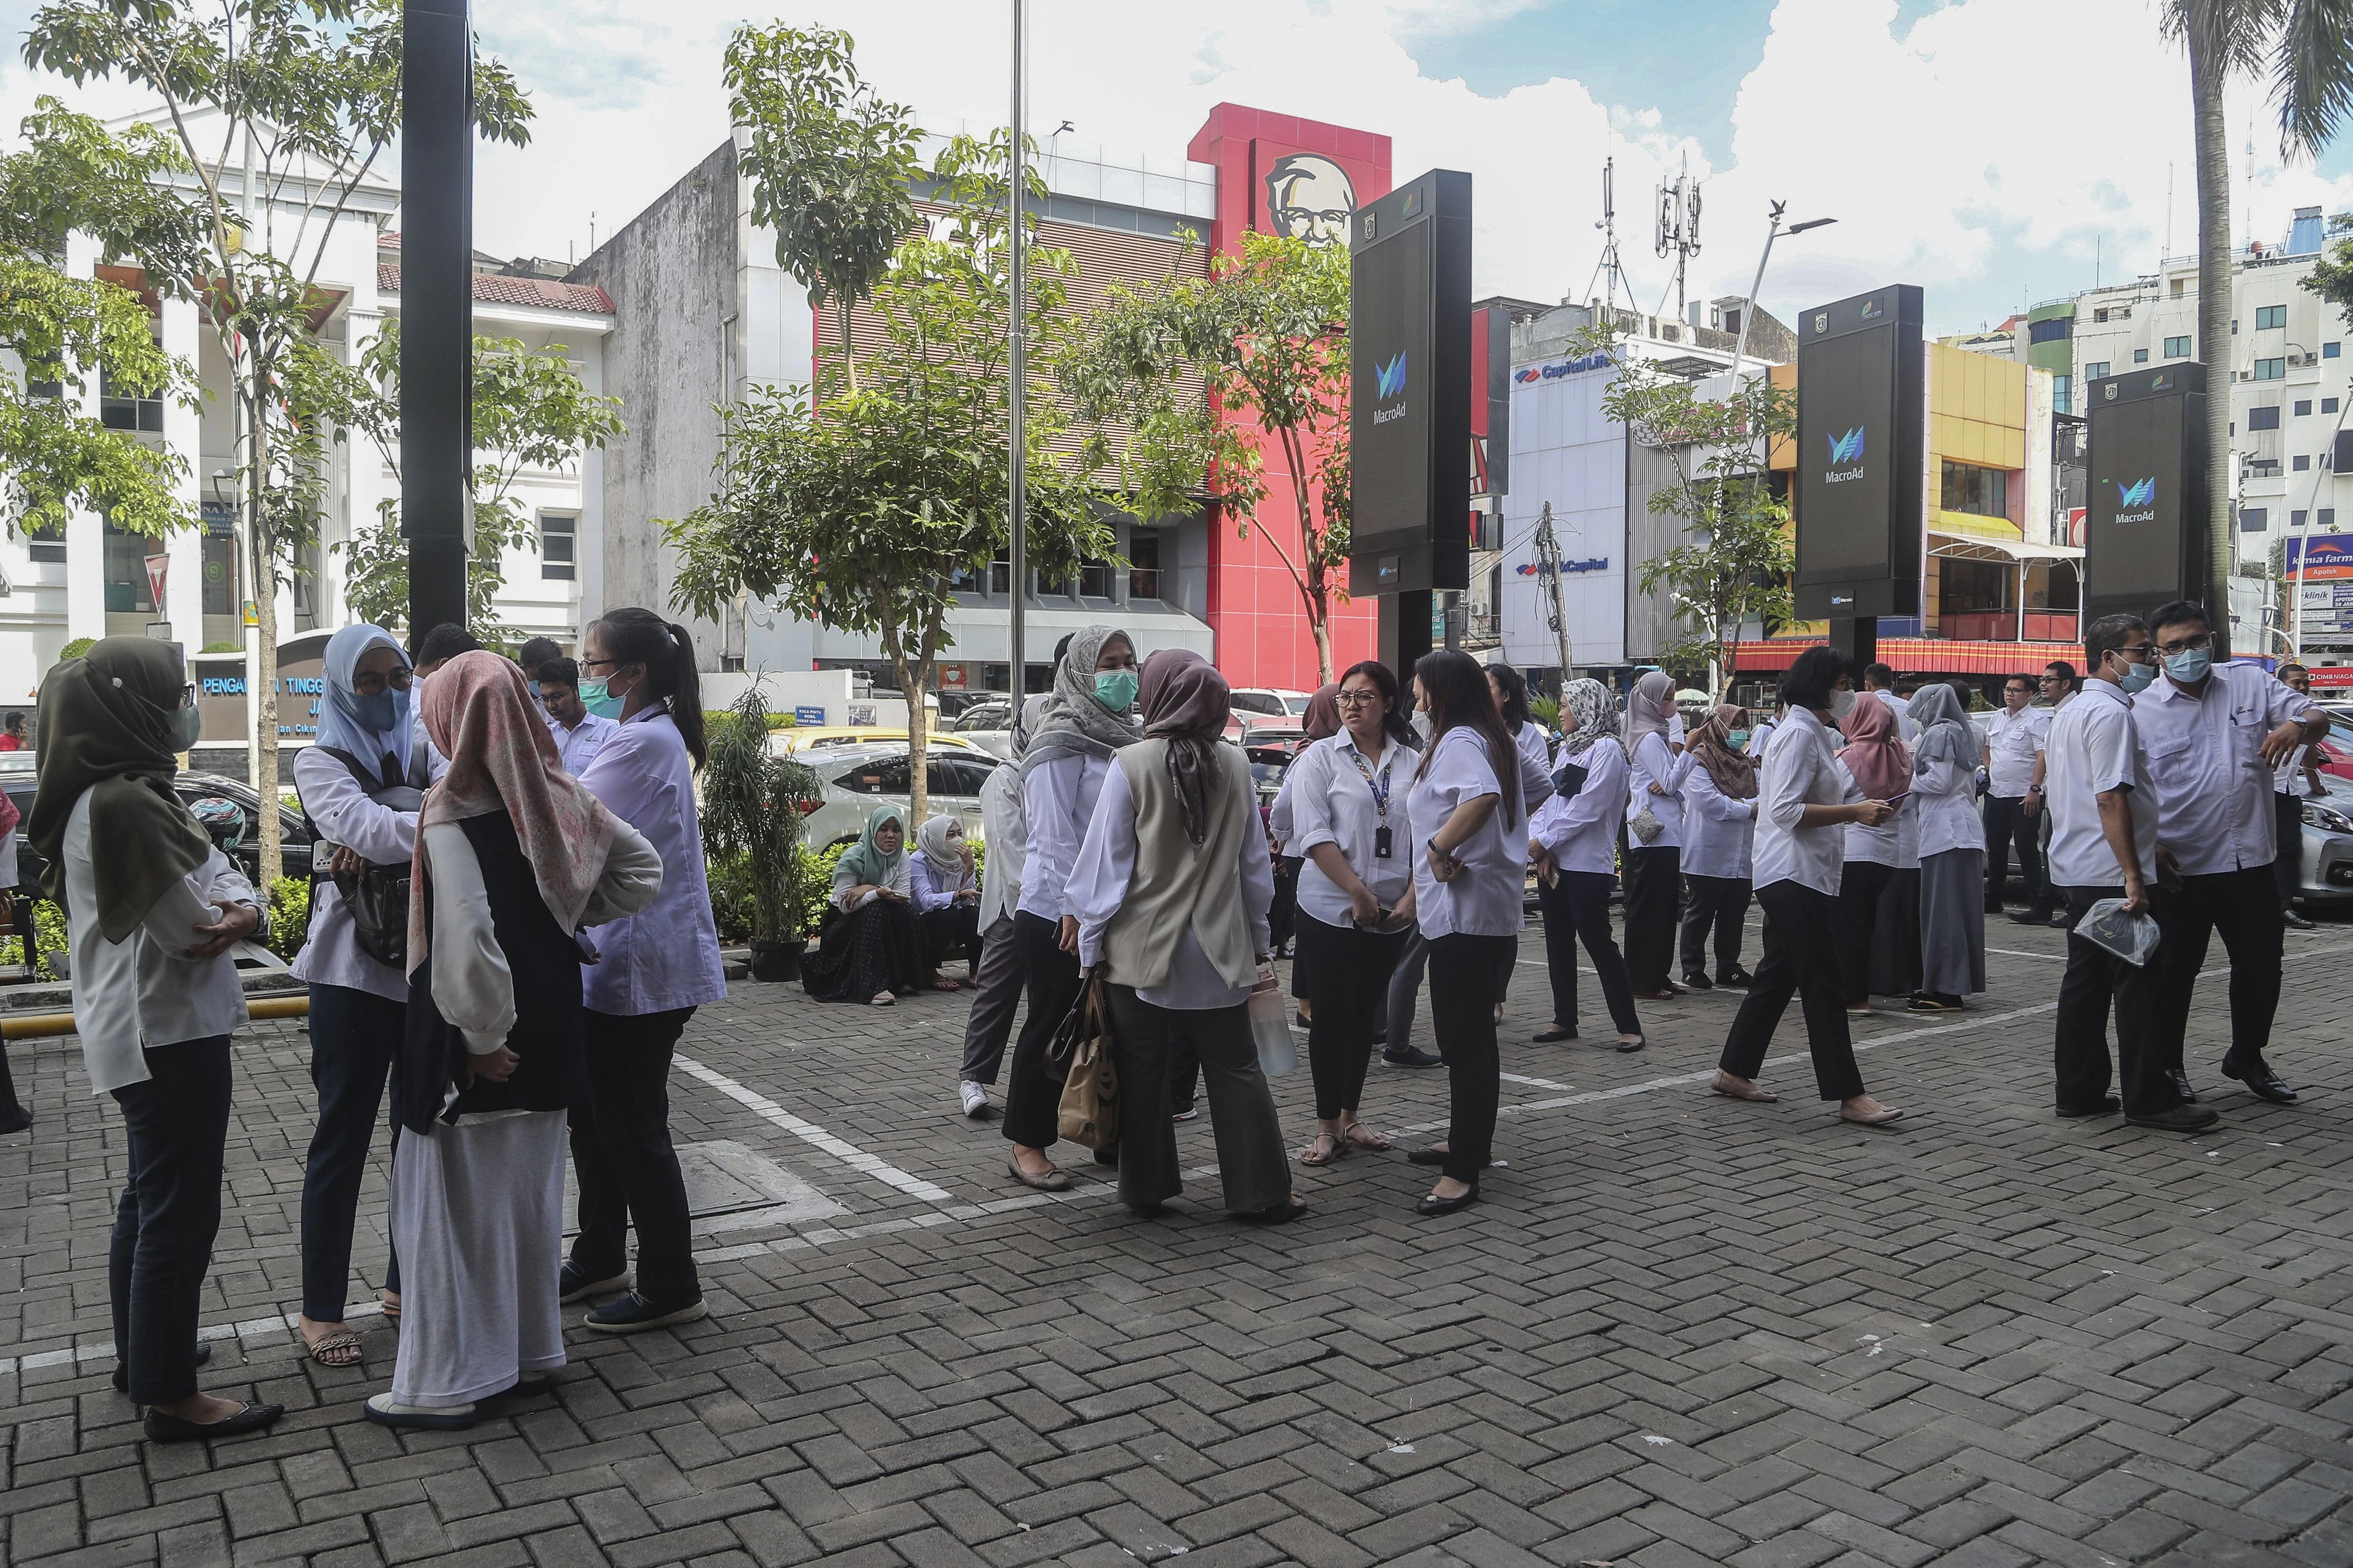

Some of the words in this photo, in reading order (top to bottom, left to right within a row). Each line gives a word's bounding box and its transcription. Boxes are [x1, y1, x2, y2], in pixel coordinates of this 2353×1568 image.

[1542, 358, 1586, 378] Capital
[1586, 355, 1611, 369] Life
[1374, 401, 1406, 425] MacroAd
[1826, 466, 1863, 483] MacroAd
[2115, 510, 2154, 523] MacroAd
[2292, 556, 2323, 565] kmia
[2325, 555, 2353, 563] farm
[2304, 591, 2328, 599] klinik
[286, 678, 323, 693] TINGG
[296, 723, 317, 732] Cikin
